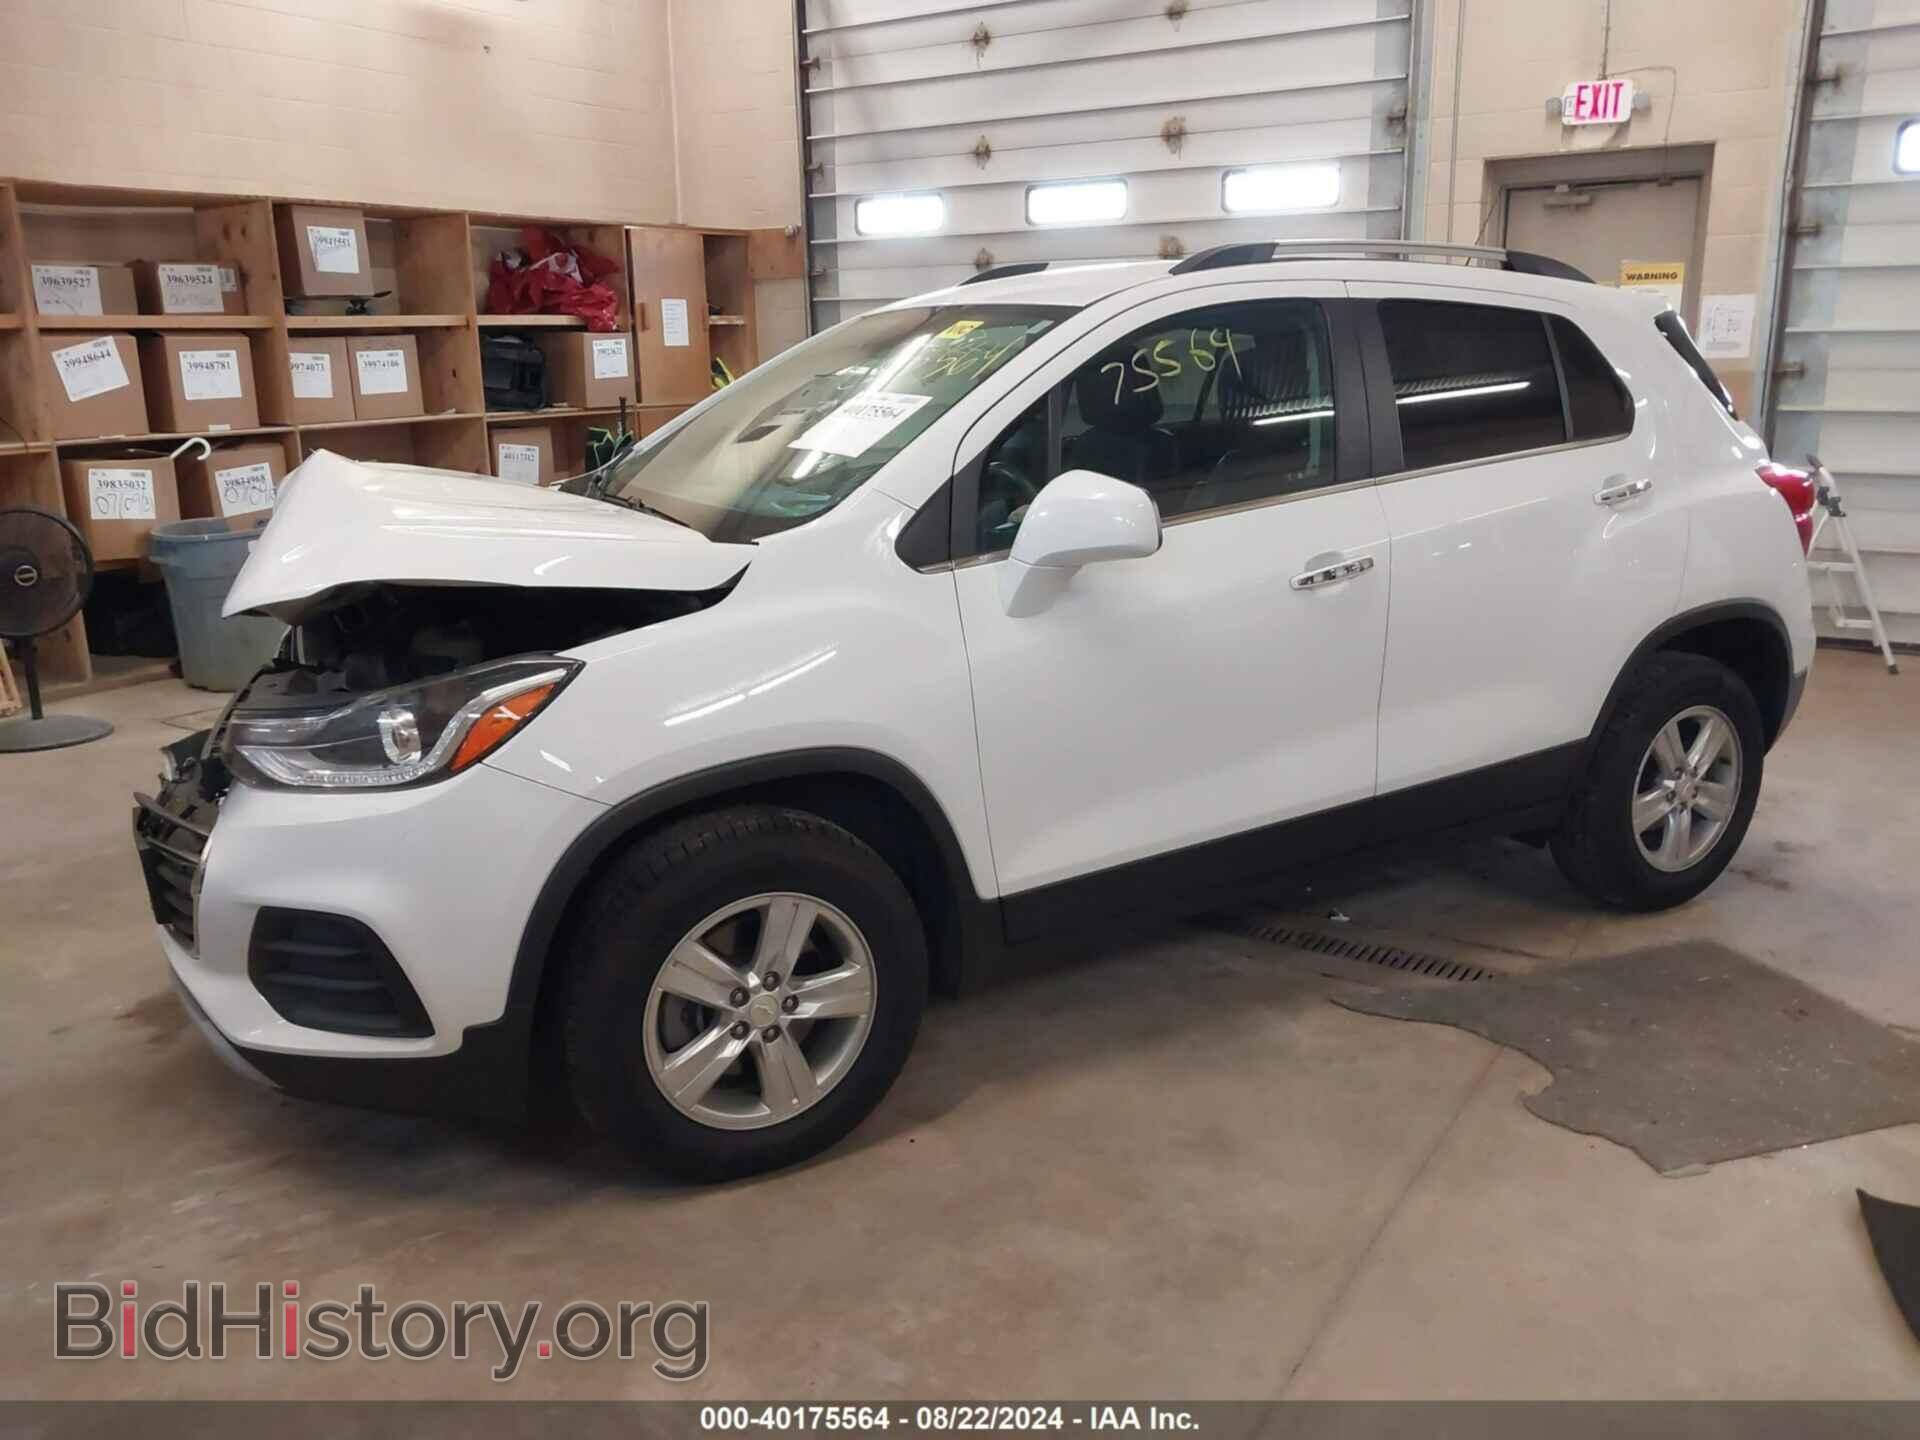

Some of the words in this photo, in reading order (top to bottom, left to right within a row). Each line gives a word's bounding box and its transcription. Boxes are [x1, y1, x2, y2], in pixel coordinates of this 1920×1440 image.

[1575, 83, 1624, 119] EXIT
[167, 274, 214, 285] 39639524
[1625, 271, 1678, 281] WARNING
[97, 479, 147, 490] 39835032
